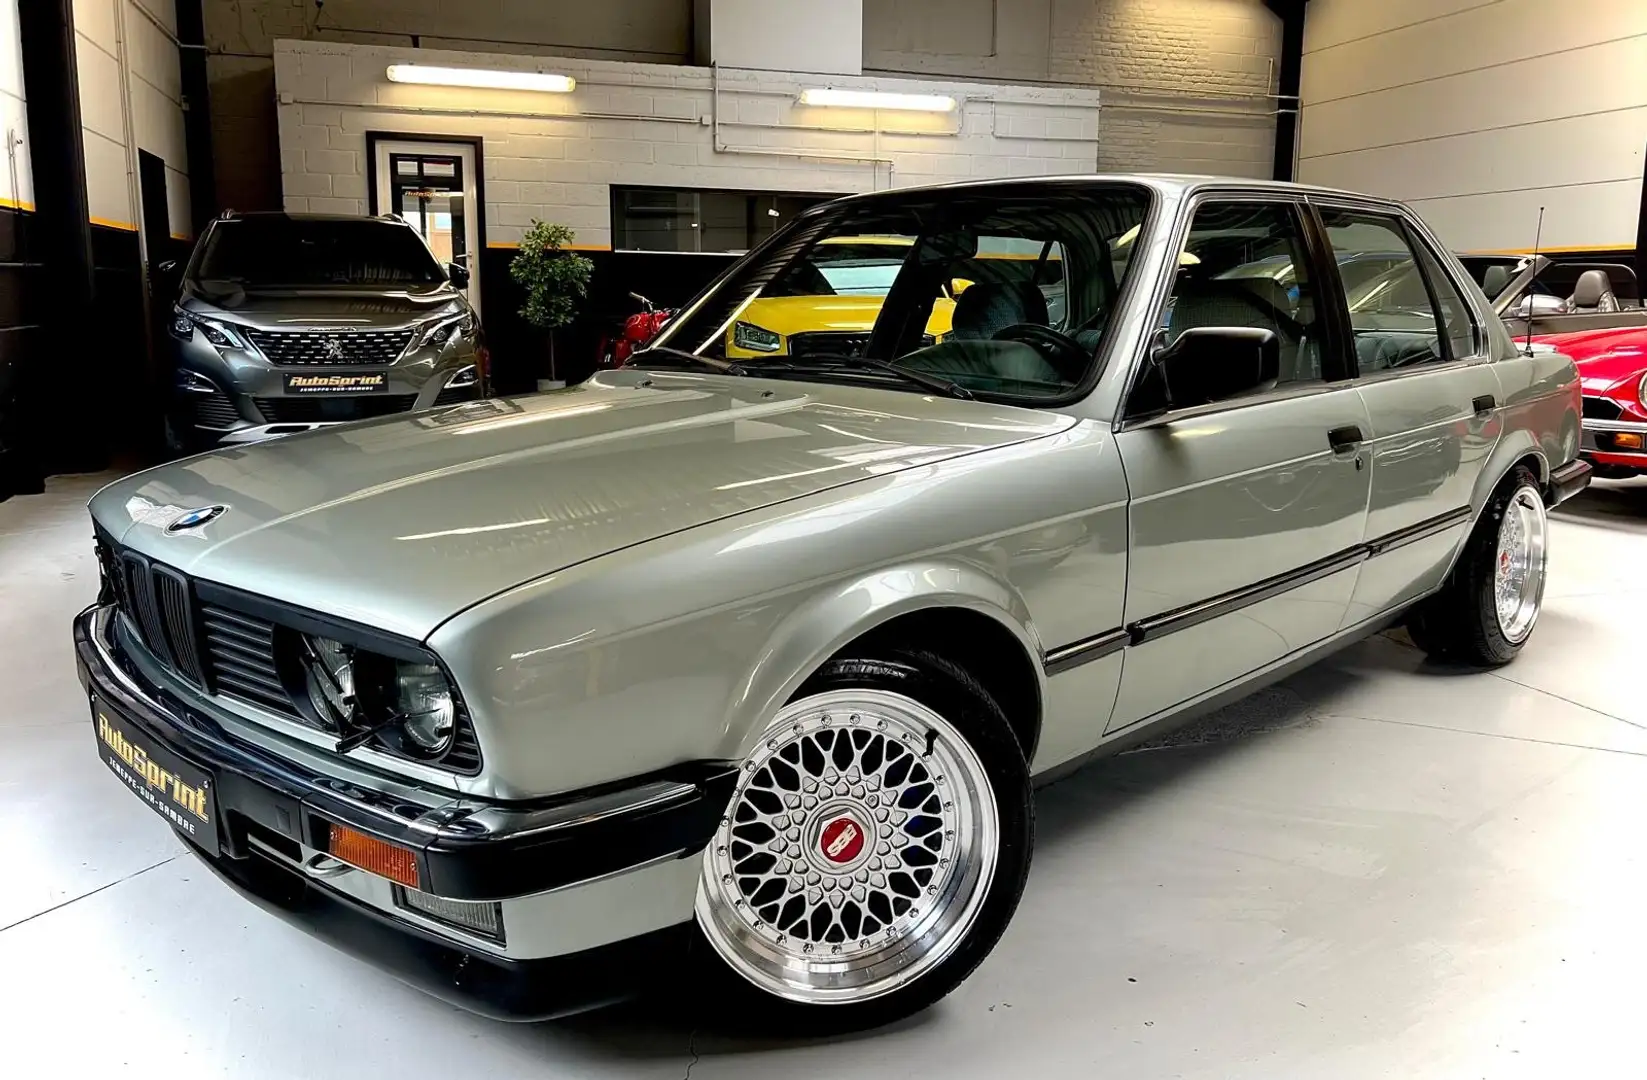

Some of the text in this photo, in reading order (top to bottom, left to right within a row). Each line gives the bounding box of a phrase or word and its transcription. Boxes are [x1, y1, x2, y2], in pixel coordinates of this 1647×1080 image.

[289, 375, 383, 388] AutoSprint
[99, 713, 209, 823] AutoSprint
[109, 756, 196, 835] JEMEPPE-SUR-SAMBRE
